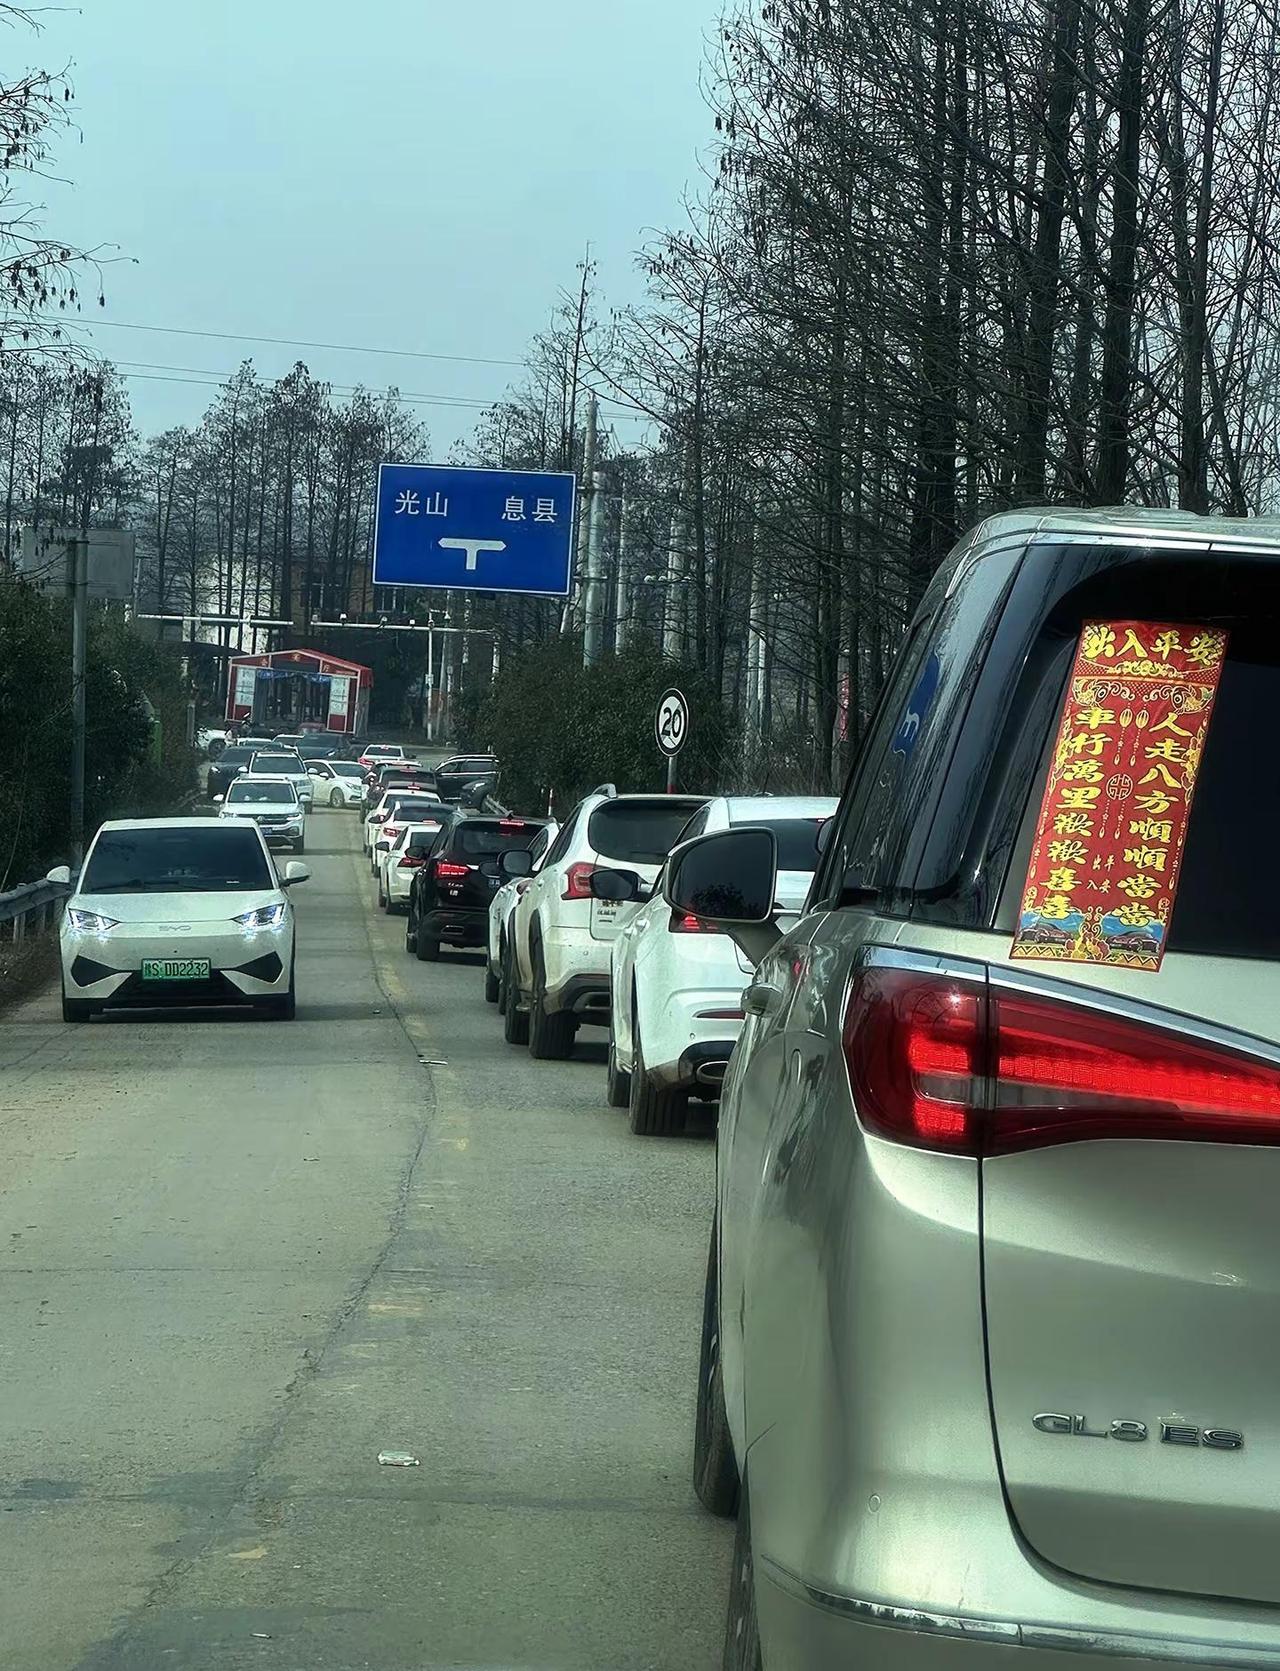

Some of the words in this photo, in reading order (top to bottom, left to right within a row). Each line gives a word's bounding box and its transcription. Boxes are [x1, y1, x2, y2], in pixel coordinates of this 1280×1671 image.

[394, 489, 448, 517] 光山
[501, 495, 558, 523] 息县
[1084, 626, 1217, 666] 出入平安
[661, 707, 682, 739] 20
[1032, 1412, 1147, 1442] GL8
[1160, 1421, 1244, 1450] ES
